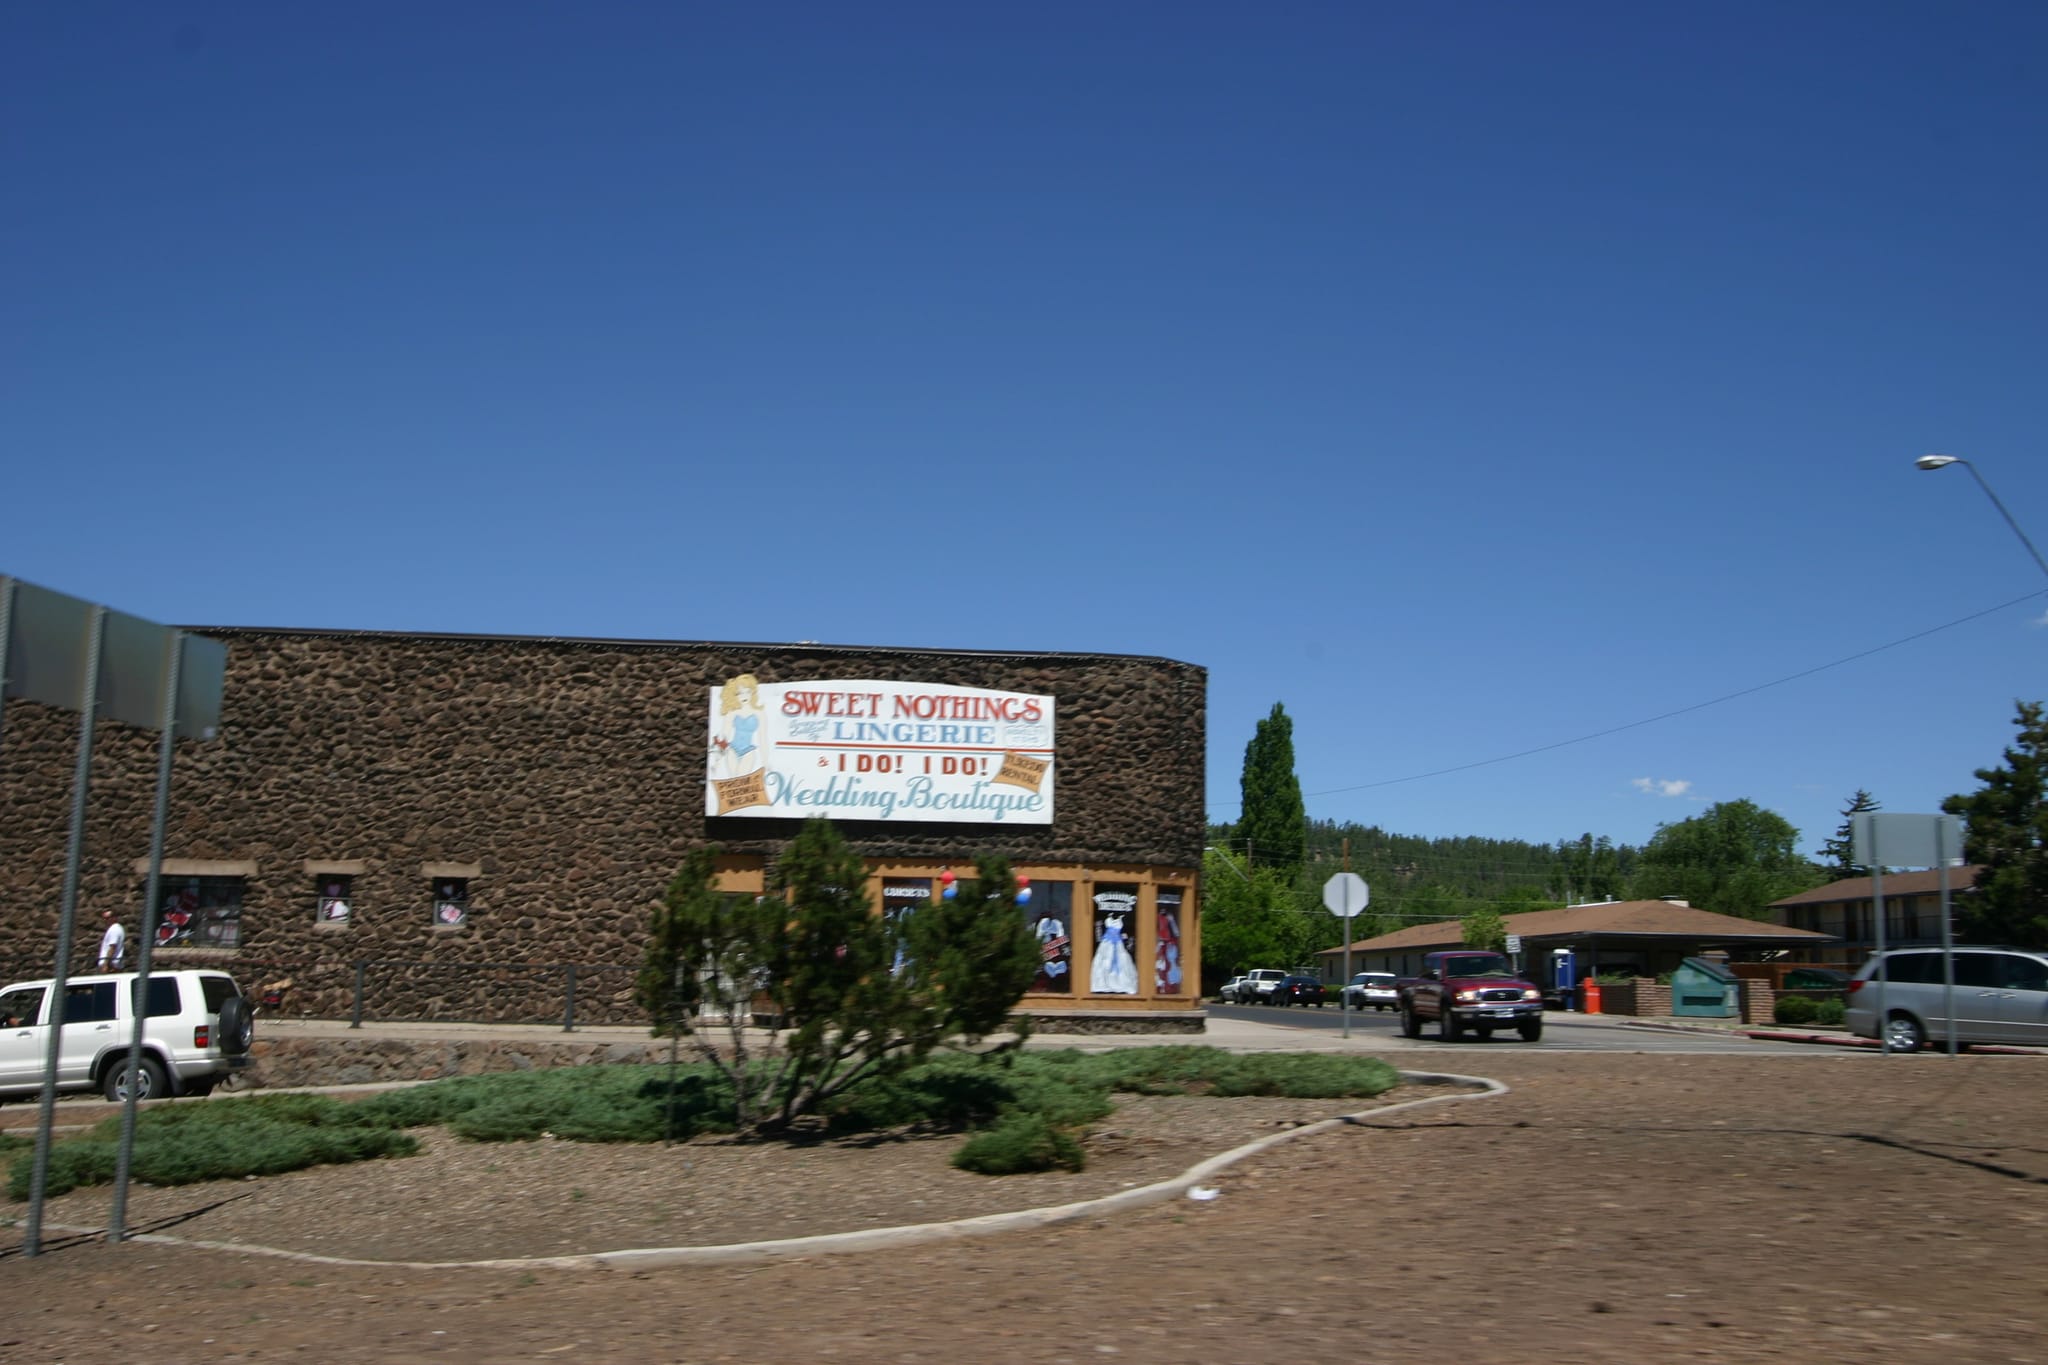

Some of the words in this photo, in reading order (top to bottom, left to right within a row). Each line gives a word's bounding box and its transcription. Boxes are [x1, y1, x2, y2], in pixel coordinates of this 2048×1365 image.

[781, 690, 883, 718] SWEET
[893, 694, 1042, 723] NOTHINGS
[833, 721, 996, 744] LINGERIE
[837, 753, 847, 772] I
[856, 754, 904, 774] DO!
[924, 756, 931, 774] I
[942, 756, 988, 776] DO!
[765, 771, 898, 818] Wedding
[898, 776, 1046, 820] Boutique
